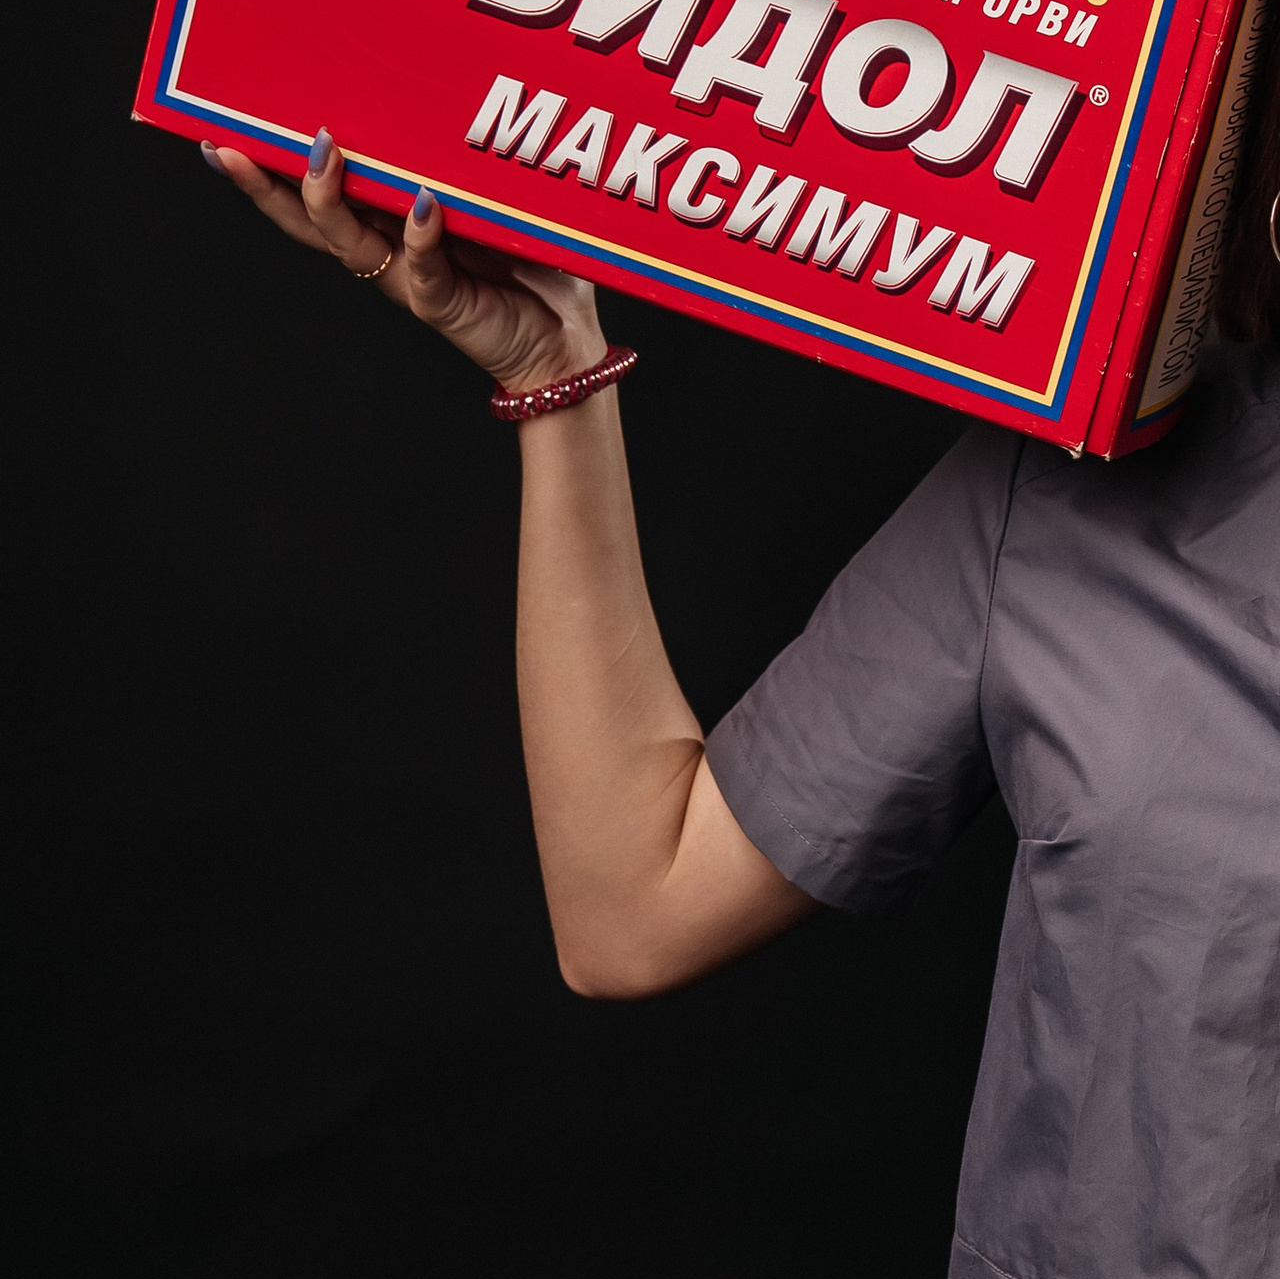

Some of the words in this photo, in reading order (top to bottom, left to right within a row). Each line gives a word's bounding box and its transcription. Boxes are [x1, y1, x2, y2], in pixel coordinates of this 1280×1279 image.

[464, 74, 1036, 331] МАКСИМУМ
[1202, 185, 1230, 218] СО
[1157, 218, 1221, 388] СПЕЦИАЛИСТОМ
